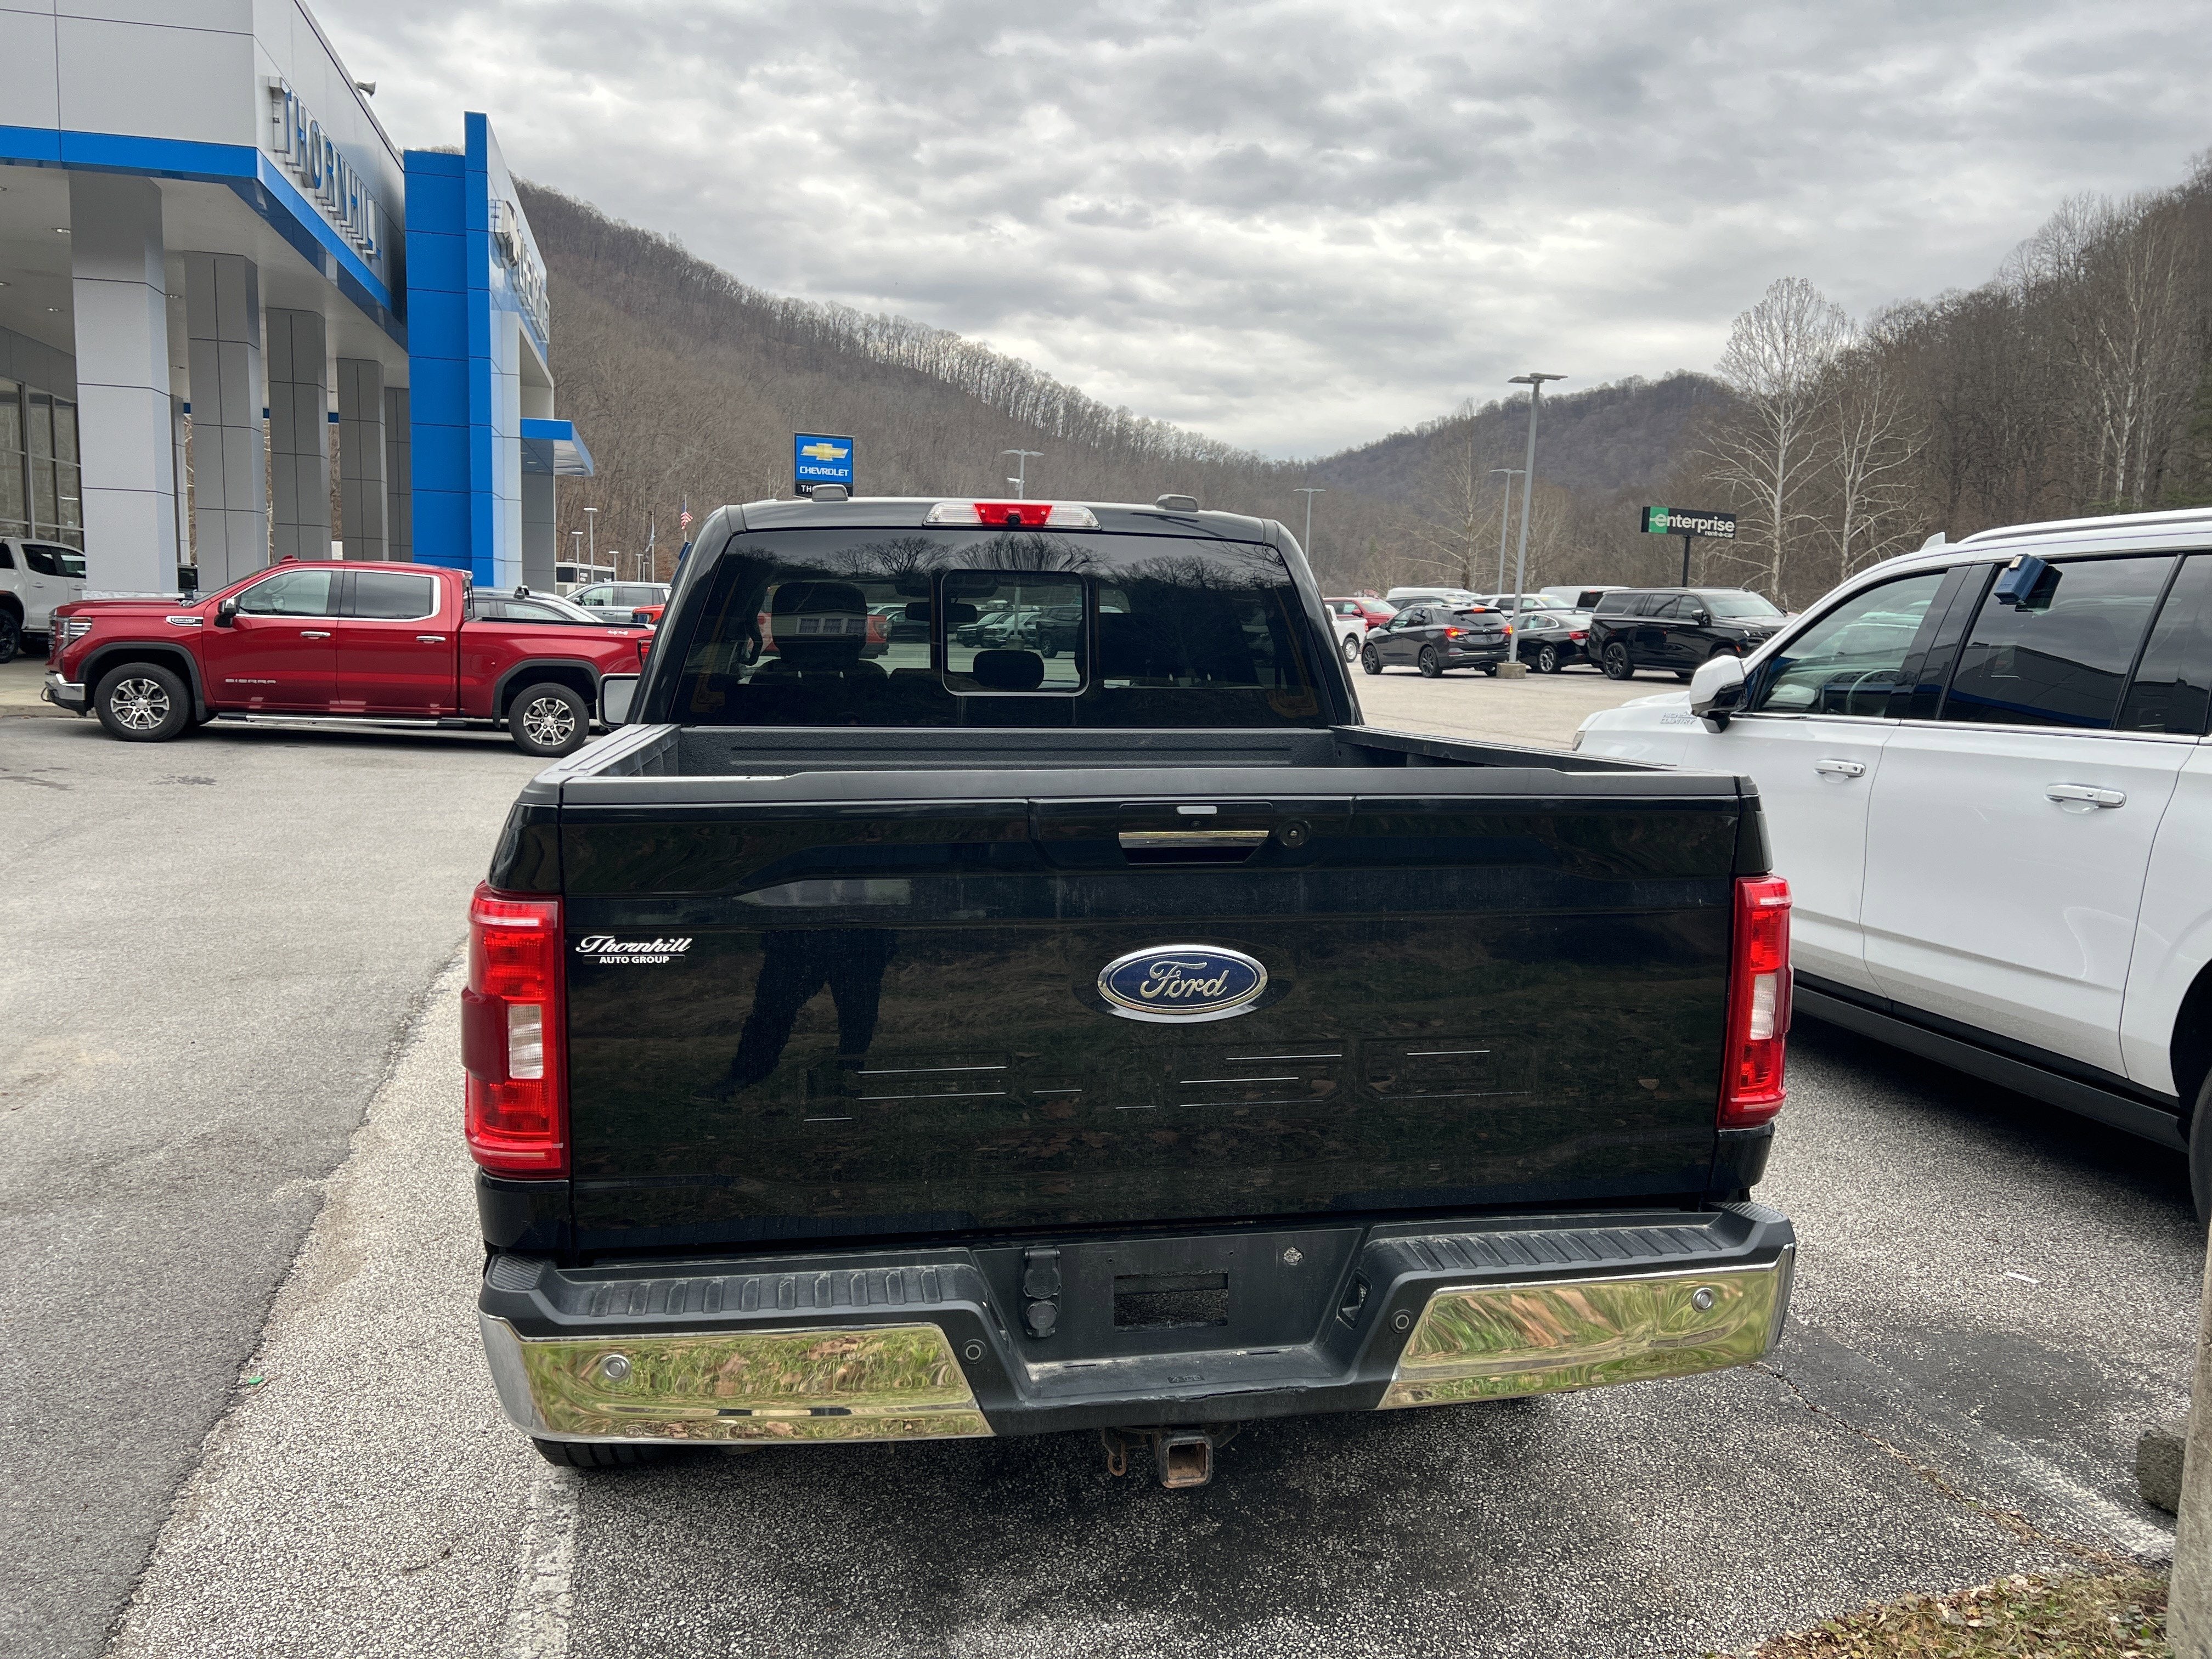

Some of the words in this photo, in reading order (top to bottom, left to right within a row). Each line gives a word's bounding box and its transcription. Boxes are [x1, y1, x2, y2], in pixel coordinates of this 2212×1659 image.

[269, 76, 381, 260] THORNHILL
[799, 466, 849, 476] CHEVROLET
[1650, 514, 1735, 533] enterprise
[575, 935, 693, 952] Thornhill
[1140, 961, 1229, 998] Ford
